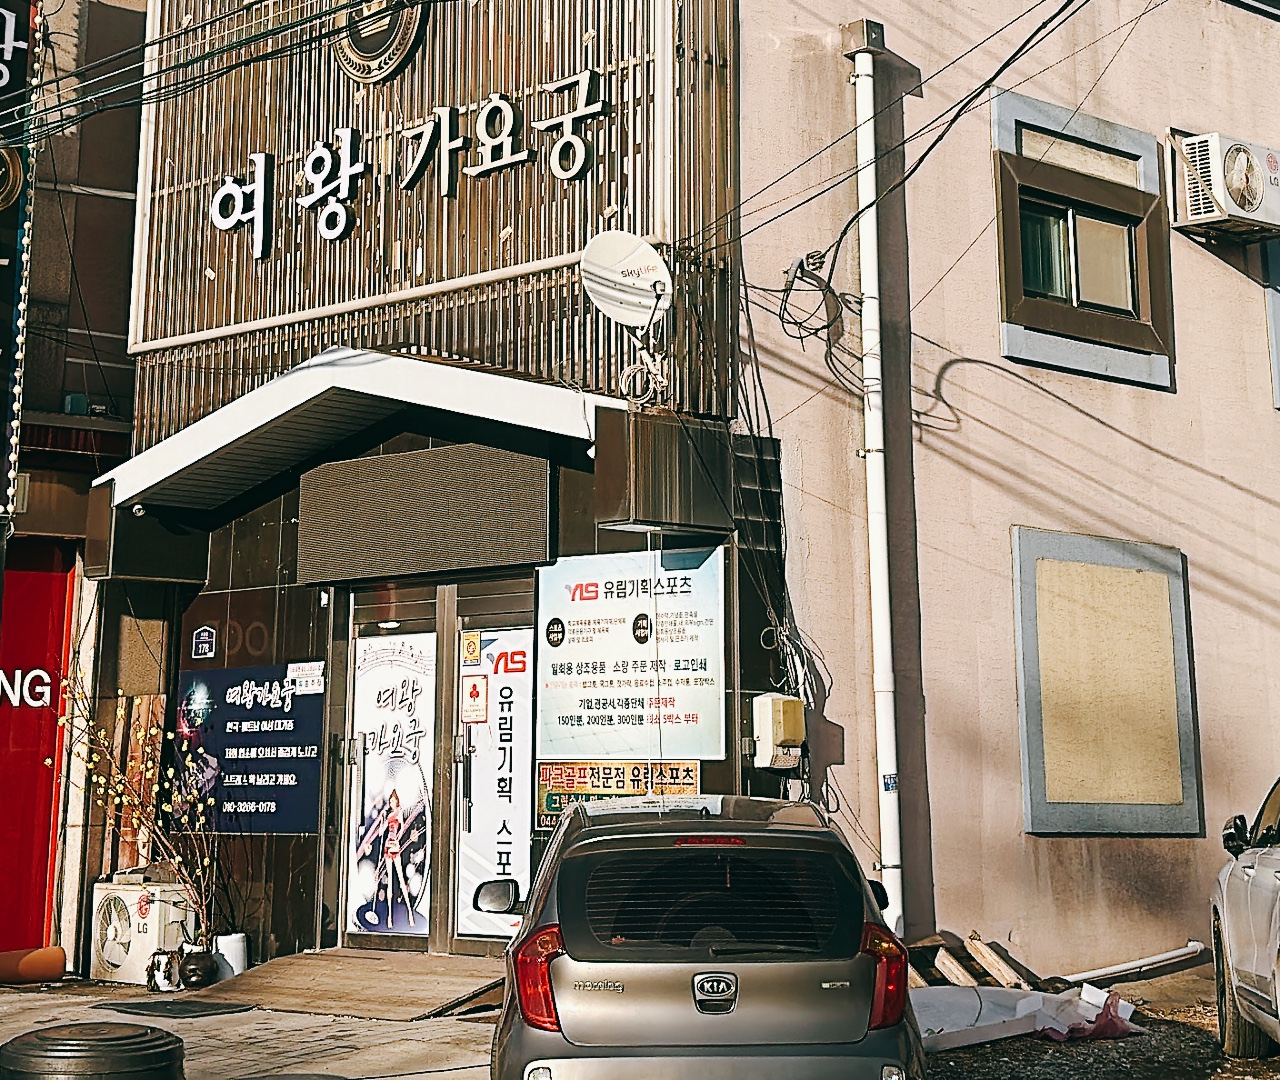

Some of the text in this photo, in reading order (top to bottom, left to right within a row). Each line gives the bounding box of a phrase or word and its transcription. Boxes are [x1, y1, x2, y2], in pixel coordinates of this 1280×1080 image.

[211, 70, 608, 260] 여왕 가요궁
[603, 576, 692, 600] 유림기획스포츠
[496, 686, 513, 876] 유림기획 스포
[540, 766, 695, 790] 파크골프전문점 유림스포츠
[137, 922, 148, 934] LG
[703, 980, 728, 994] KIA
